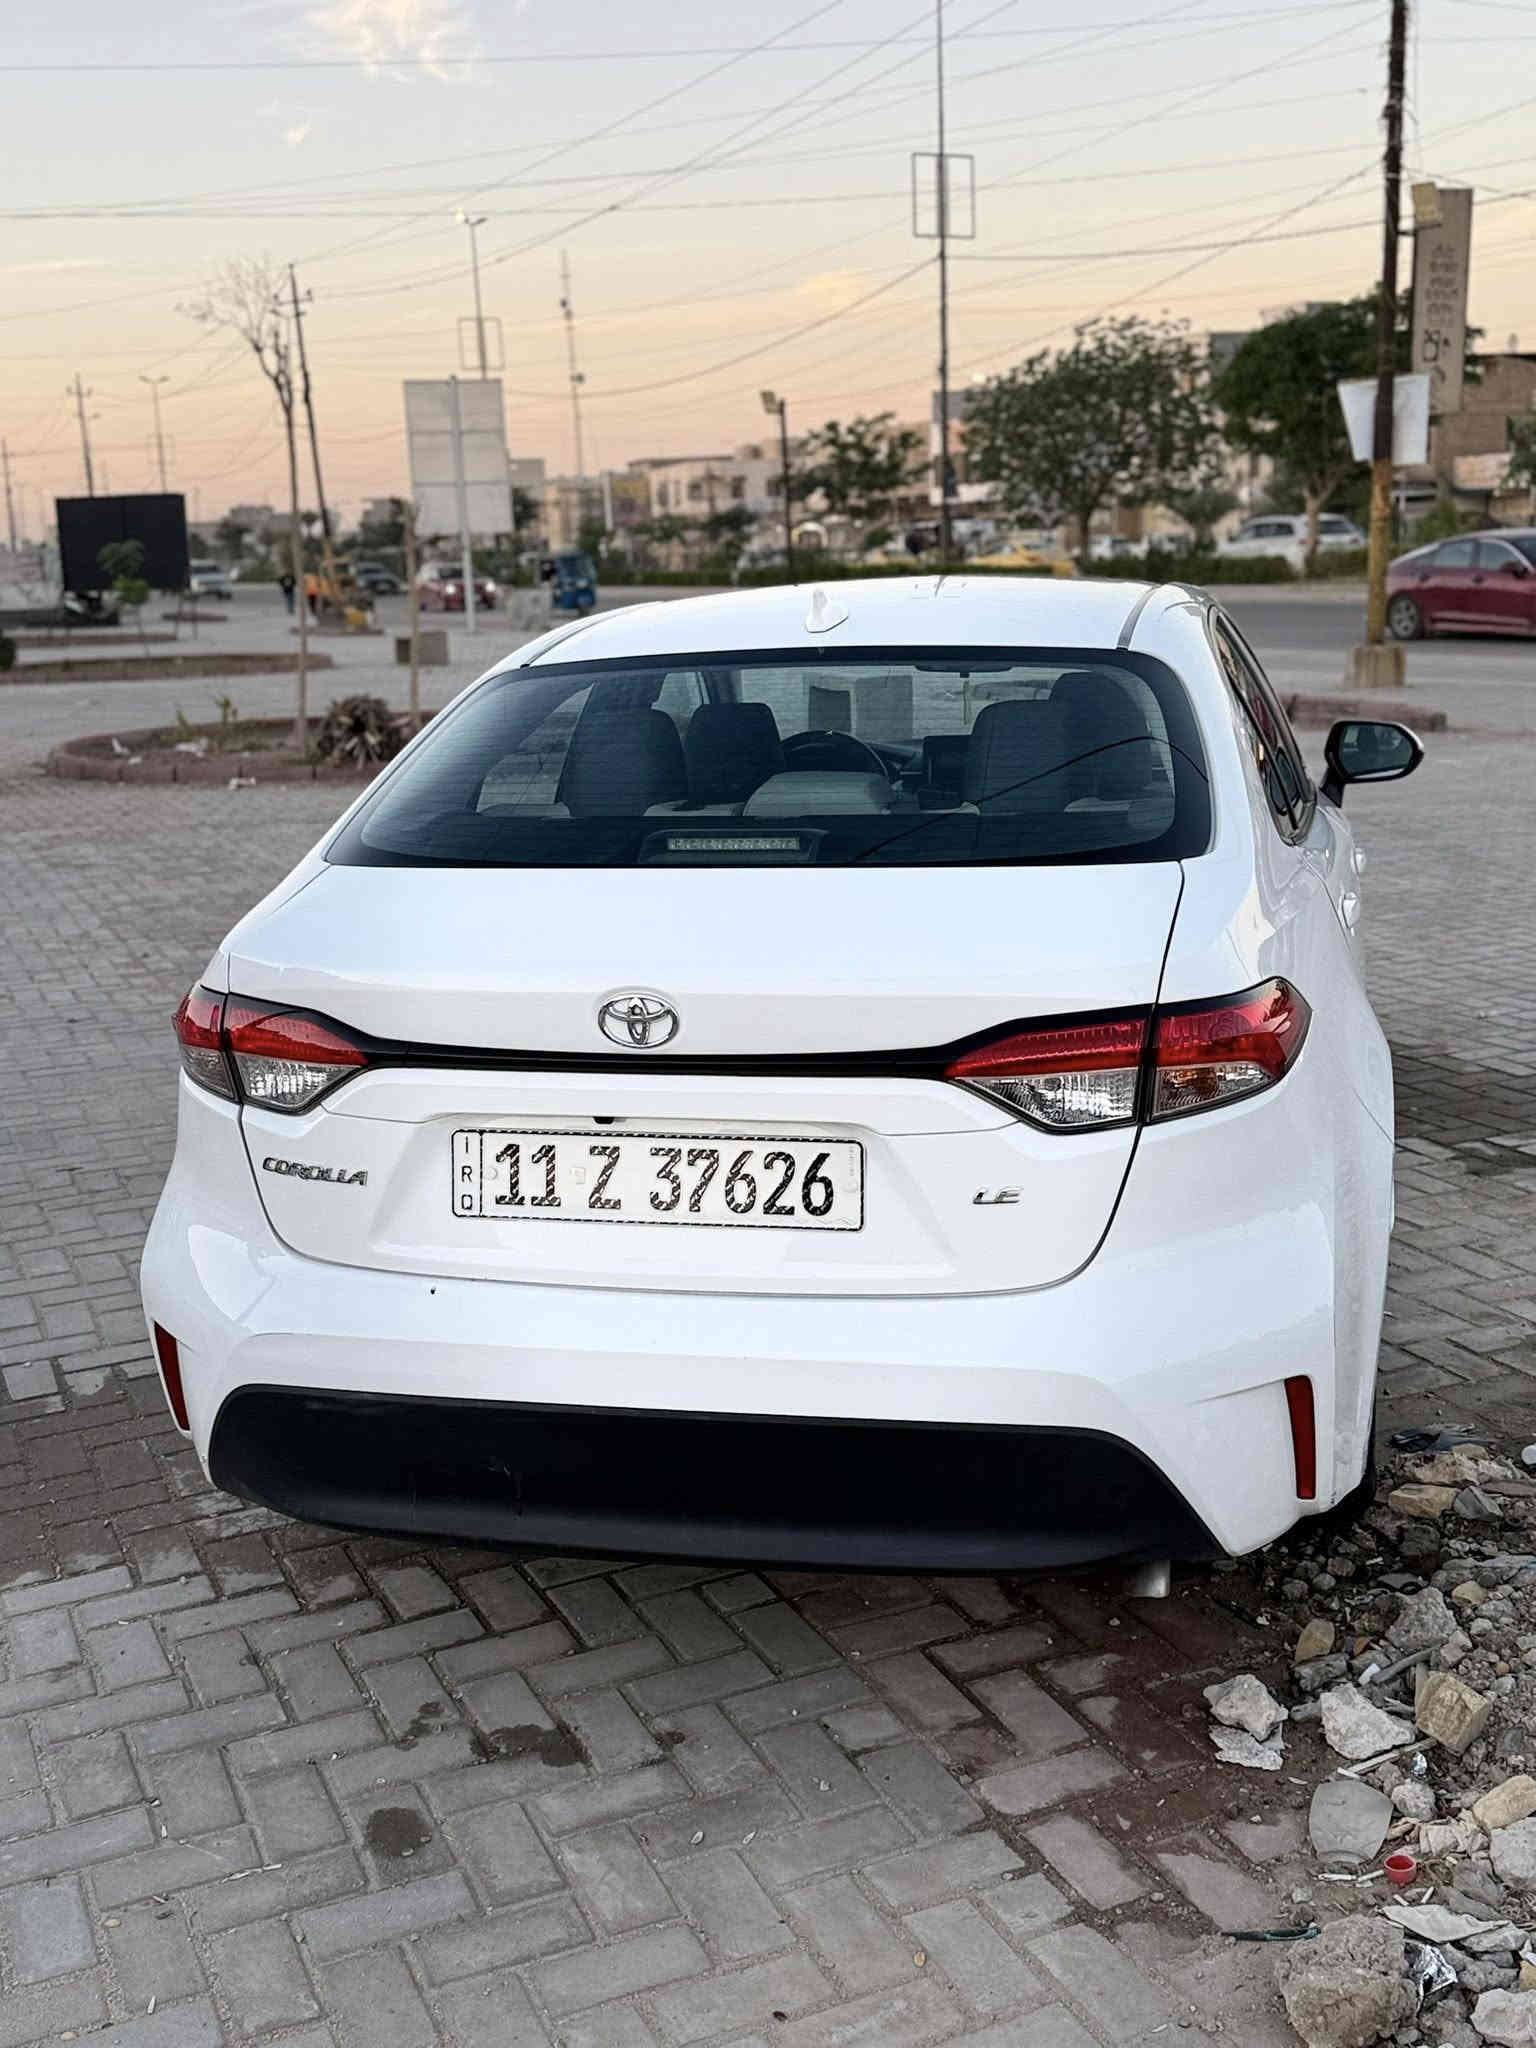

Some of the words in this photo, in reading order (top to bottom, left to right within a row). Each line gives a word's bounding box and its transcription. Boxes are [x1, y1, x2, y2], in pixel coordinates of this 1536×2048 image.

[262, 1157, 368, 1186] COROLLA
[495, 1143, 562, 1206] 11
[588, 1145, 622, 1209] Z
[649, 1146, 834, 1217] 37626
[972, 1187, 1022, 1205] LE
